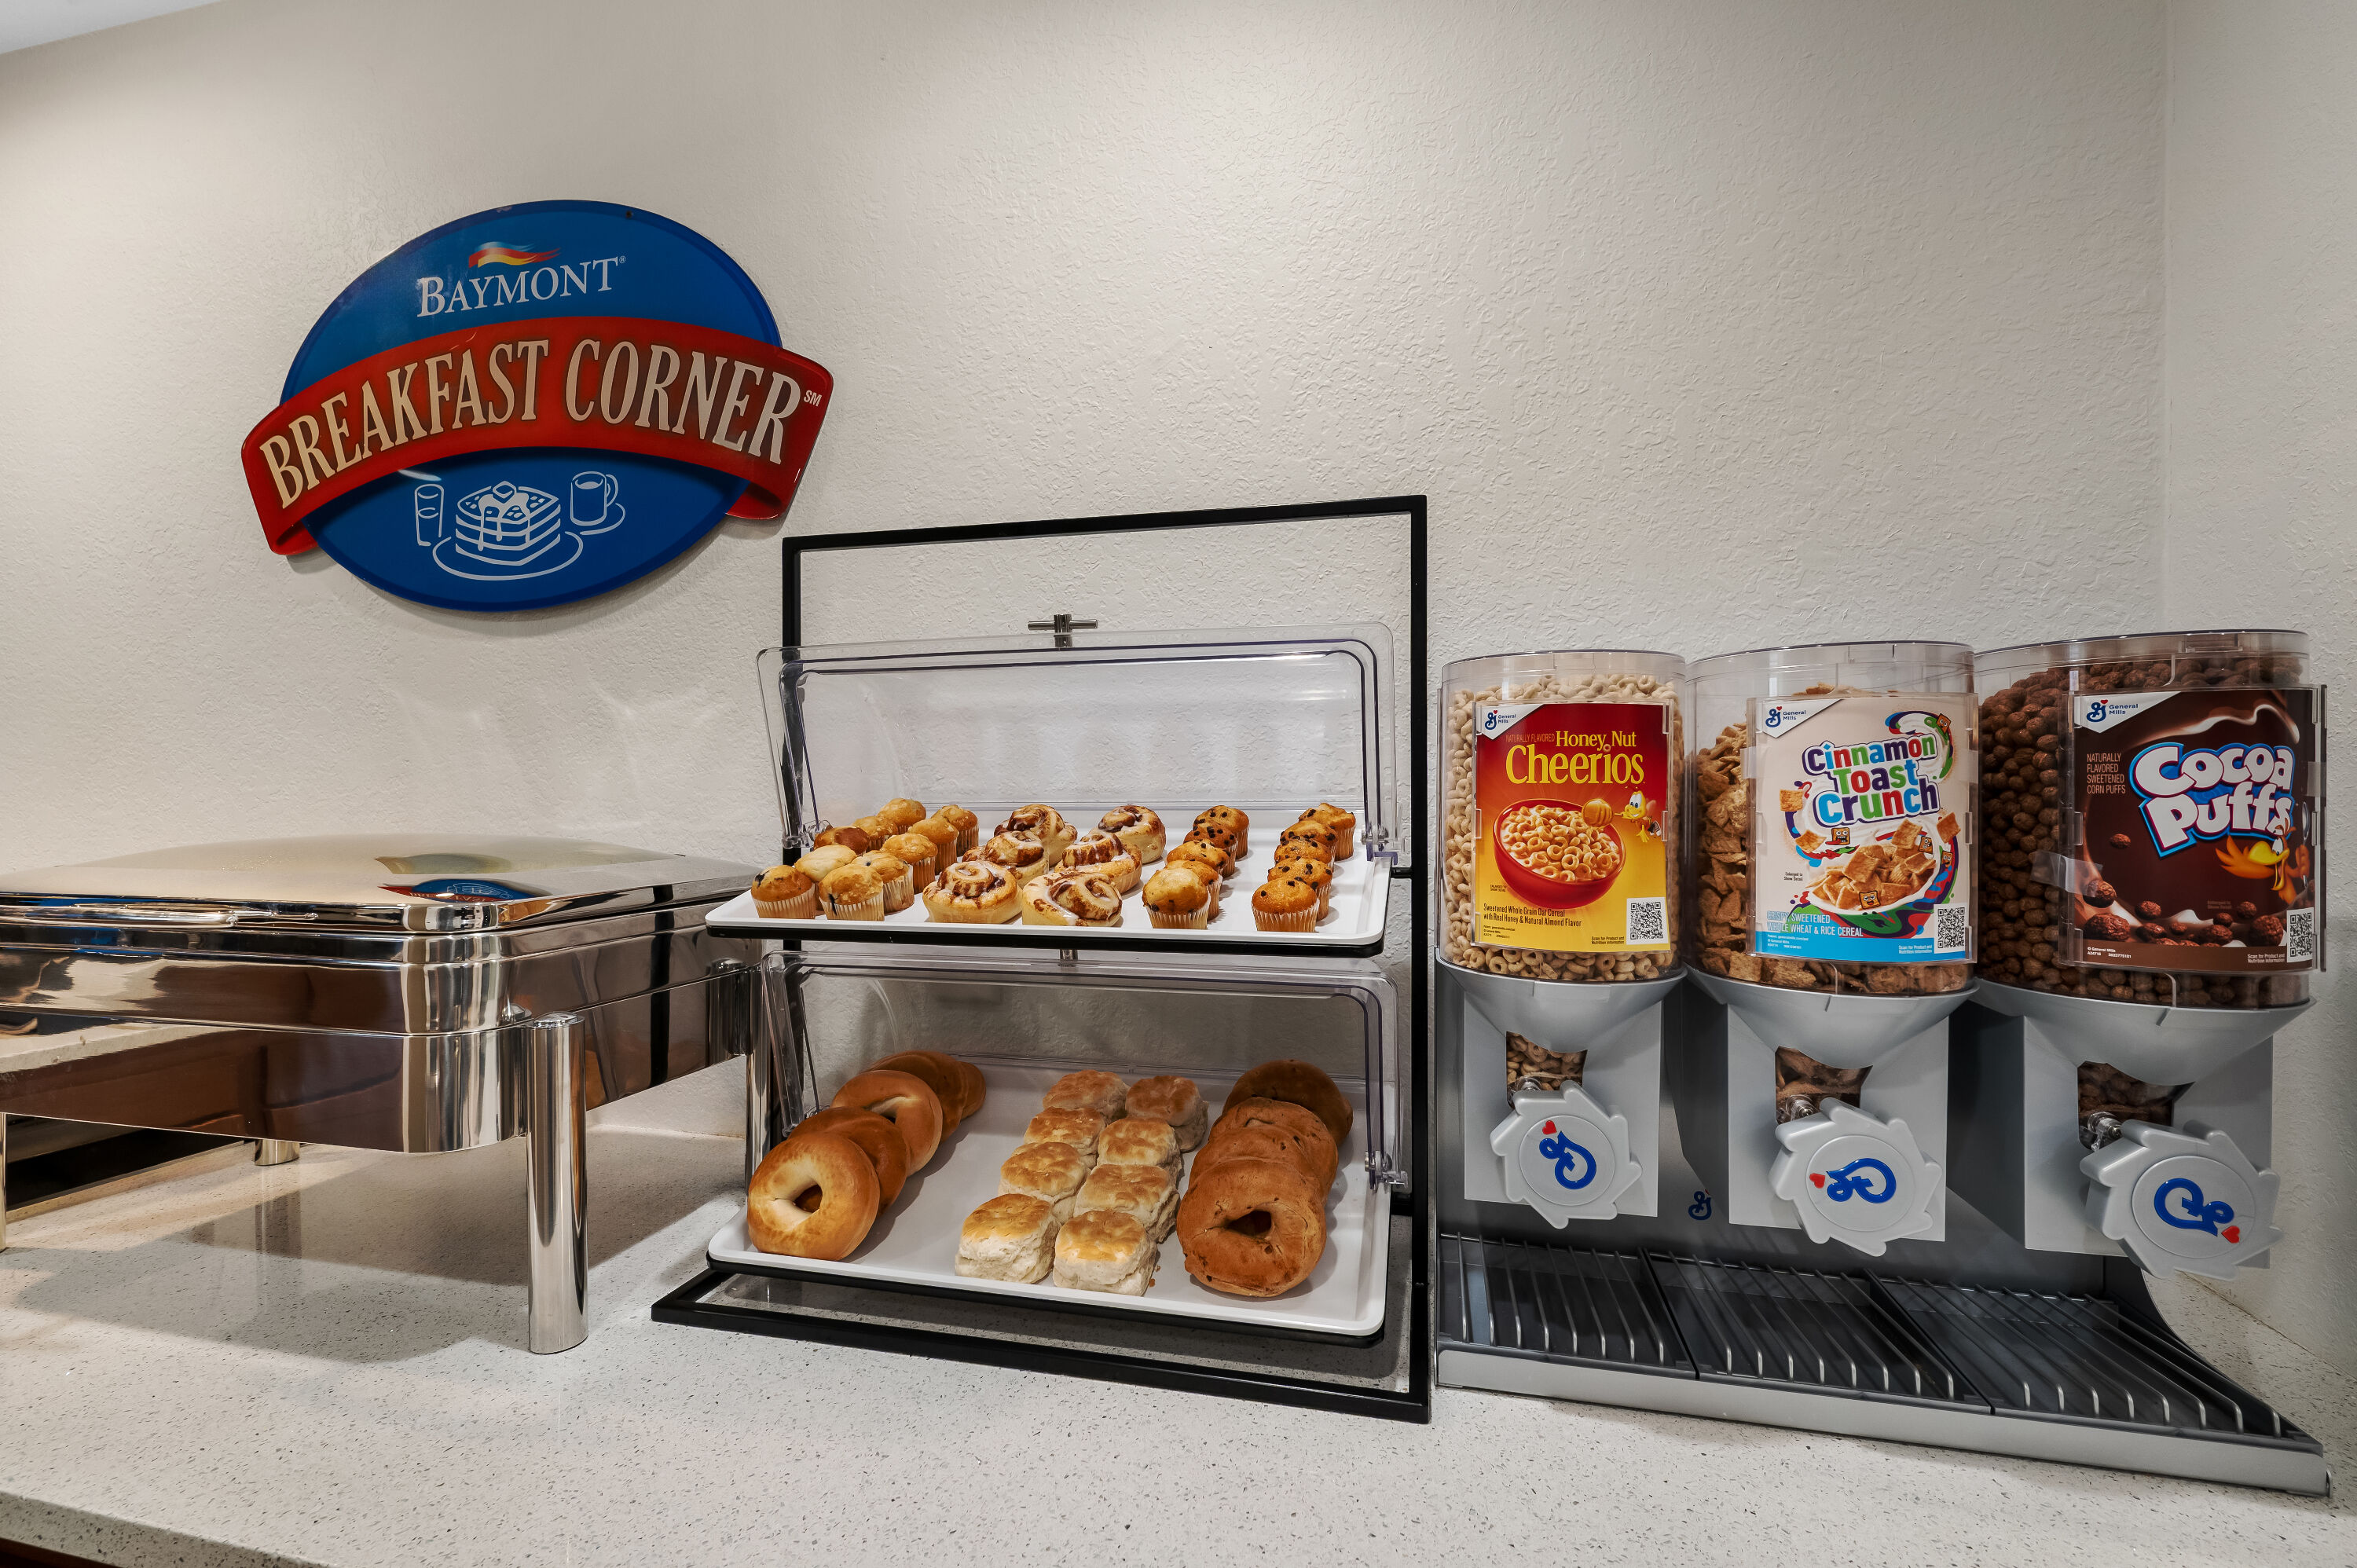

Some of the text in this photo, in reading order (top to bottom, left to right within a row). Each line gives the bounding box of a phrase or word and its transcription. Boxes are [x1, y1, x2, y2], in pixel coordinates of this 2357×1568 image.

[259, 339, 549, 511] BREAKFAST
[568, 339, 801, 466] CORNER
[1505, 733, 1556, 743] NATURALLY FLAVORED
[1556, 731, 1637, 751] Honey Nut
[1807, 735, 1936, 771] Cinnamon
[2087, 753, 2121, 763] NATURALLY
[1505, 744, 1645, 785] Cheerios
[2087, 764, 2119, 773] FLAVORED
[2135, 746, 2293, 797] Cocoa
[1833, 759, 1919, 795] Toast
[2087, 774, 2124, 784] SWEETENED
[2087, 784, 2126, 794] CORN PUFFS
[1818, 778, 1938, 823] Crunch
[2145, 781, 2292, 849] Puffs
[1483, 903, 1508, 913] Sweetened
[1508, 906, 1523, 914] Whole
[1523, 907, 1538, 916] Grain
[1548, 909, 1565, 918] Cereal
[1791, 913, 1831, 924] SWEETENED
[1494, 913, 1504, 921] Real
[1505, 914, 1519, 924] Honey
[1524, 916, 1544, 925] Natural
[1545, 918, 1564, 926] Almond
[1565, 918, 1582, 927] Flavor
[1766, 921, 1789, 932] WHOLE
[1790, 924, 1813, 934] WHEAT
[1820, 926, 1835, 936] RICE
[1838, 927, 1864, 937] CEREAL
